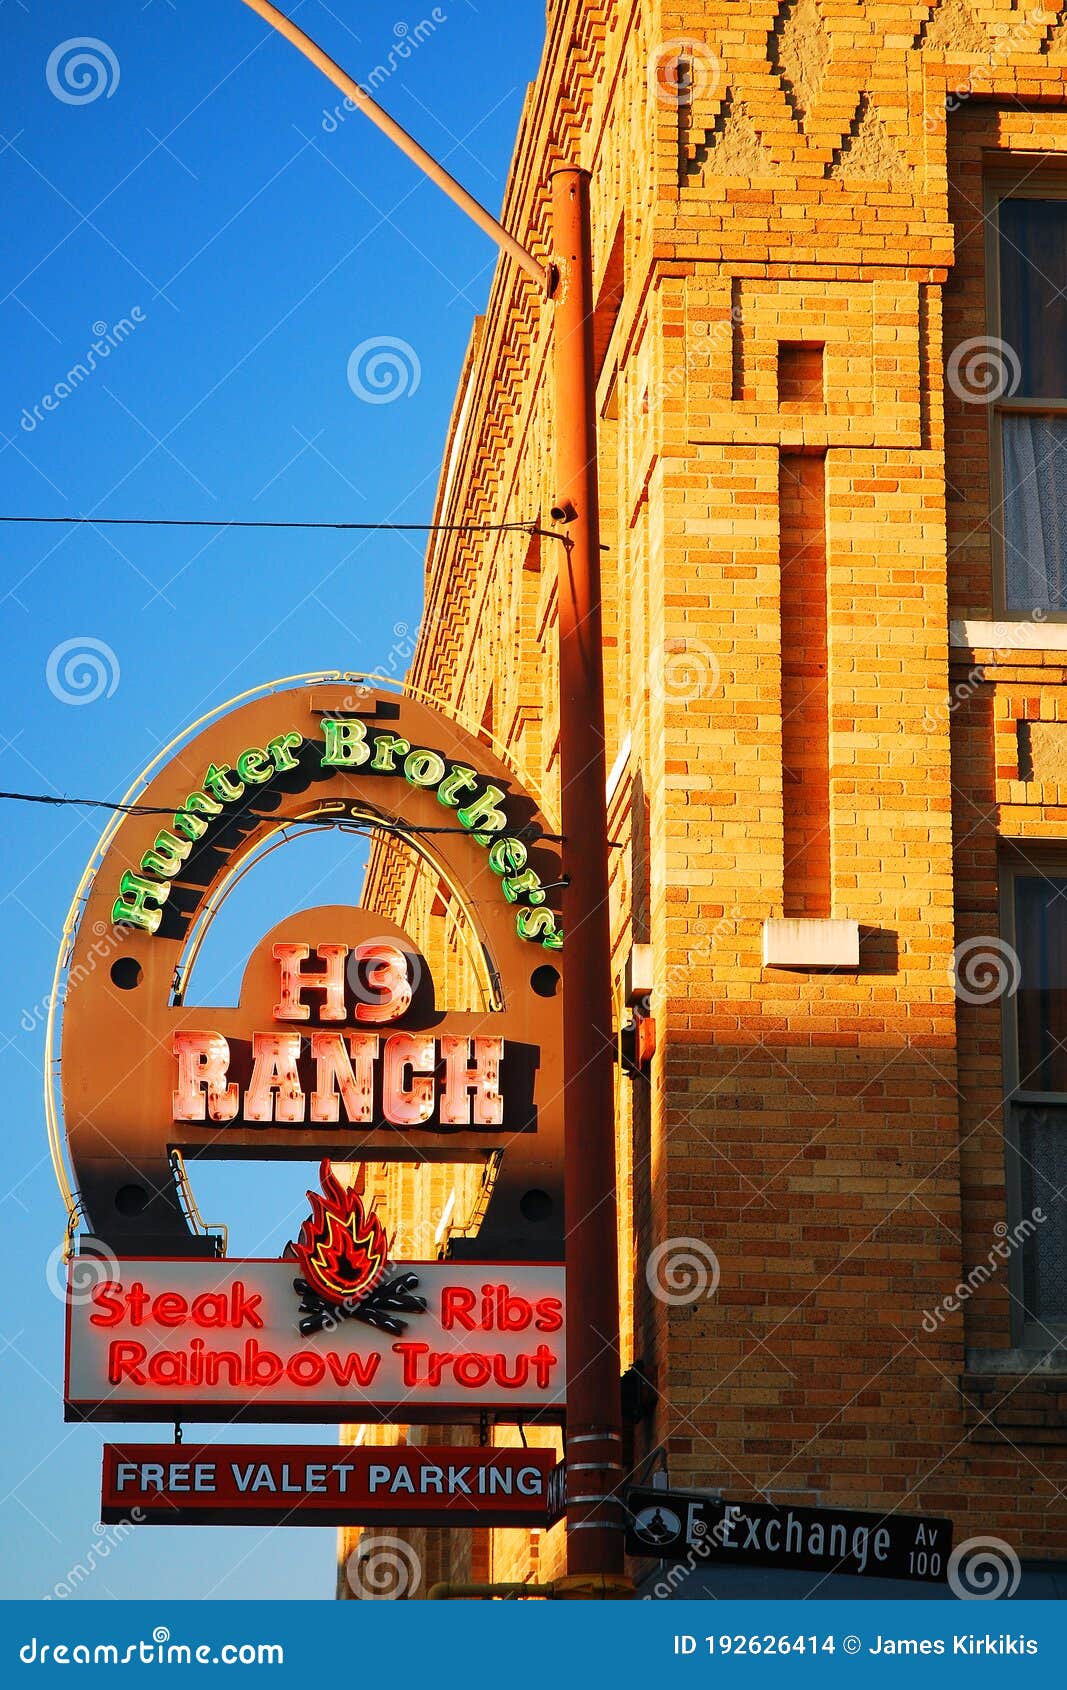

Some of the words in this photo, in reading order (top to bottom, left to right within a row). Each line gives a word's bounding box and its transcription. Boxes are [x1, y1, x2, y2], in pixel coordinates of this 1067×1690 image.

[111, 731, 302, 935] Hunter
[272, 943, 413, 1022] H3
[172, 1030, 504, 1124] RANCH
[90, 1281, 264, 1329] Steak
[441, 1286, 563, 1332] Ribs
[108, 1339, 380, 1387] Rainbow
[392, 1342, 557, 1389] Trout
[116, 1463, 216, 1492] FREE
[231, 1464, 354, 1493] VALET
[369, 1465, 542, 1495] PARKING
[686, 1503, 704, 1544] E
[722, 1506, 890, 1573] Exchange
[915, 1523, 938, 1546] Av
[909, 1552, 941, 1576] 100
